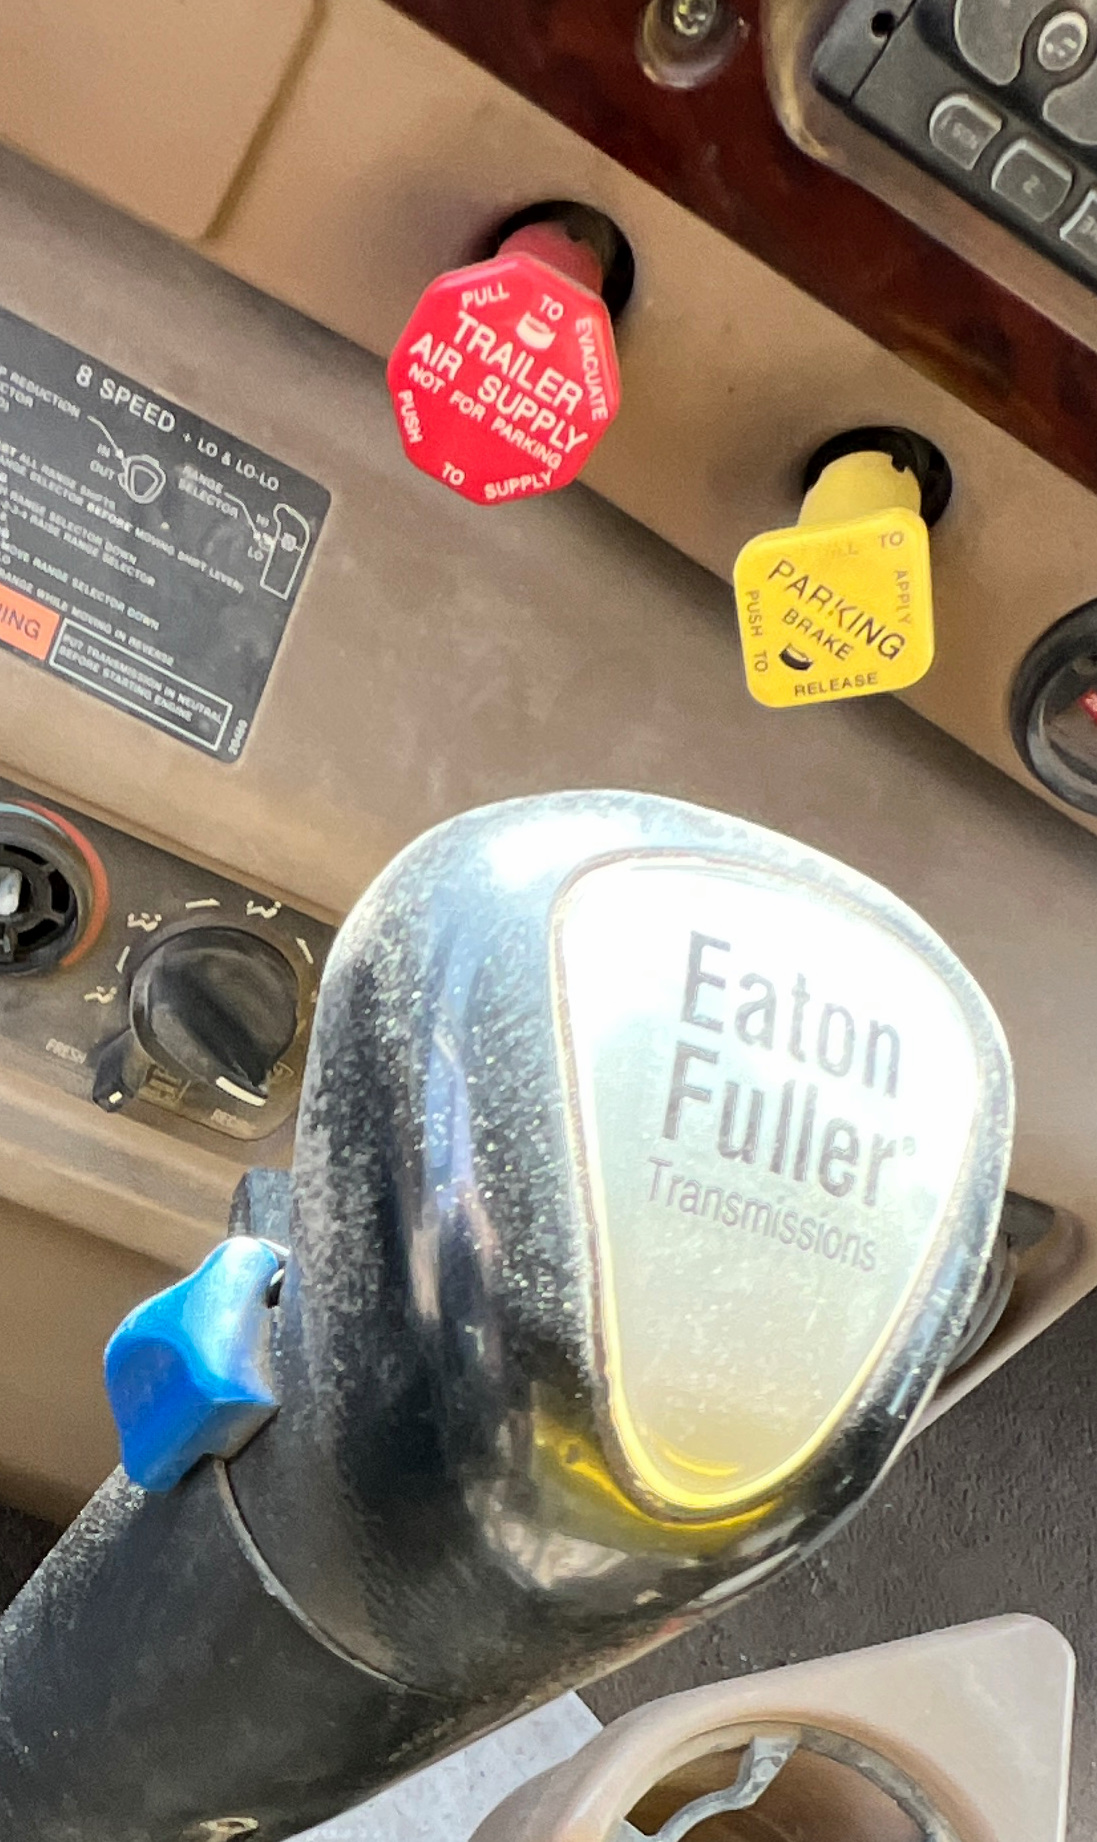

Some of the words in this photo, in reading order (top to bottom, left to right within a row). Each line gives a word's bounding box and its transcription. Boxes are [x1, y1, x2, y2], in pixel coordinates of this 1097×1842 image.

[461, 282, 510, 309] PULL
[539, 294, 564, 321] TO
[453, 311, 584, 416] TRAILER
[575, 317, 609, 421] EVACUATE
[10, 372, 80, 417] REDUCTION
[398, 389, 423, 444] PUSH
[408, 362, 446, 393] NOT
[449, 390, 486, 422] FOR
[490, 417, 563, 470] PARKING
[409, 332, 463, 381] AIR
[478, 374, 588, 453] SUPPLY
[76, 365, 92, 387] 8
[100, 378, 174, 431] SPEED
[197, 437, 218, 457] LO
[235, 459, 279, 491] LO-LO
[89, 460, 115, 480] OUT
[442, 461, 465, 485] TO
[484, 470, 554, 500] SUPPLY
[178, 478, 238, 518] SELECTOR
[247, 546, 264, 561] LO
[880, 531, 904, 548] TO
[767, 558, 907, 661] PARKING
[894, 570, 912, 625] APPLY
[745, 589, 763, 637] PUSH
[754, 650, 769, 673] TO
[781, 607, 854, 661] BRAKE
[794, 671, 878, 697] RELEASE
[680, 929, 901, 1099] Eaton
[647, 1155, 877, 1272] Transmissions
